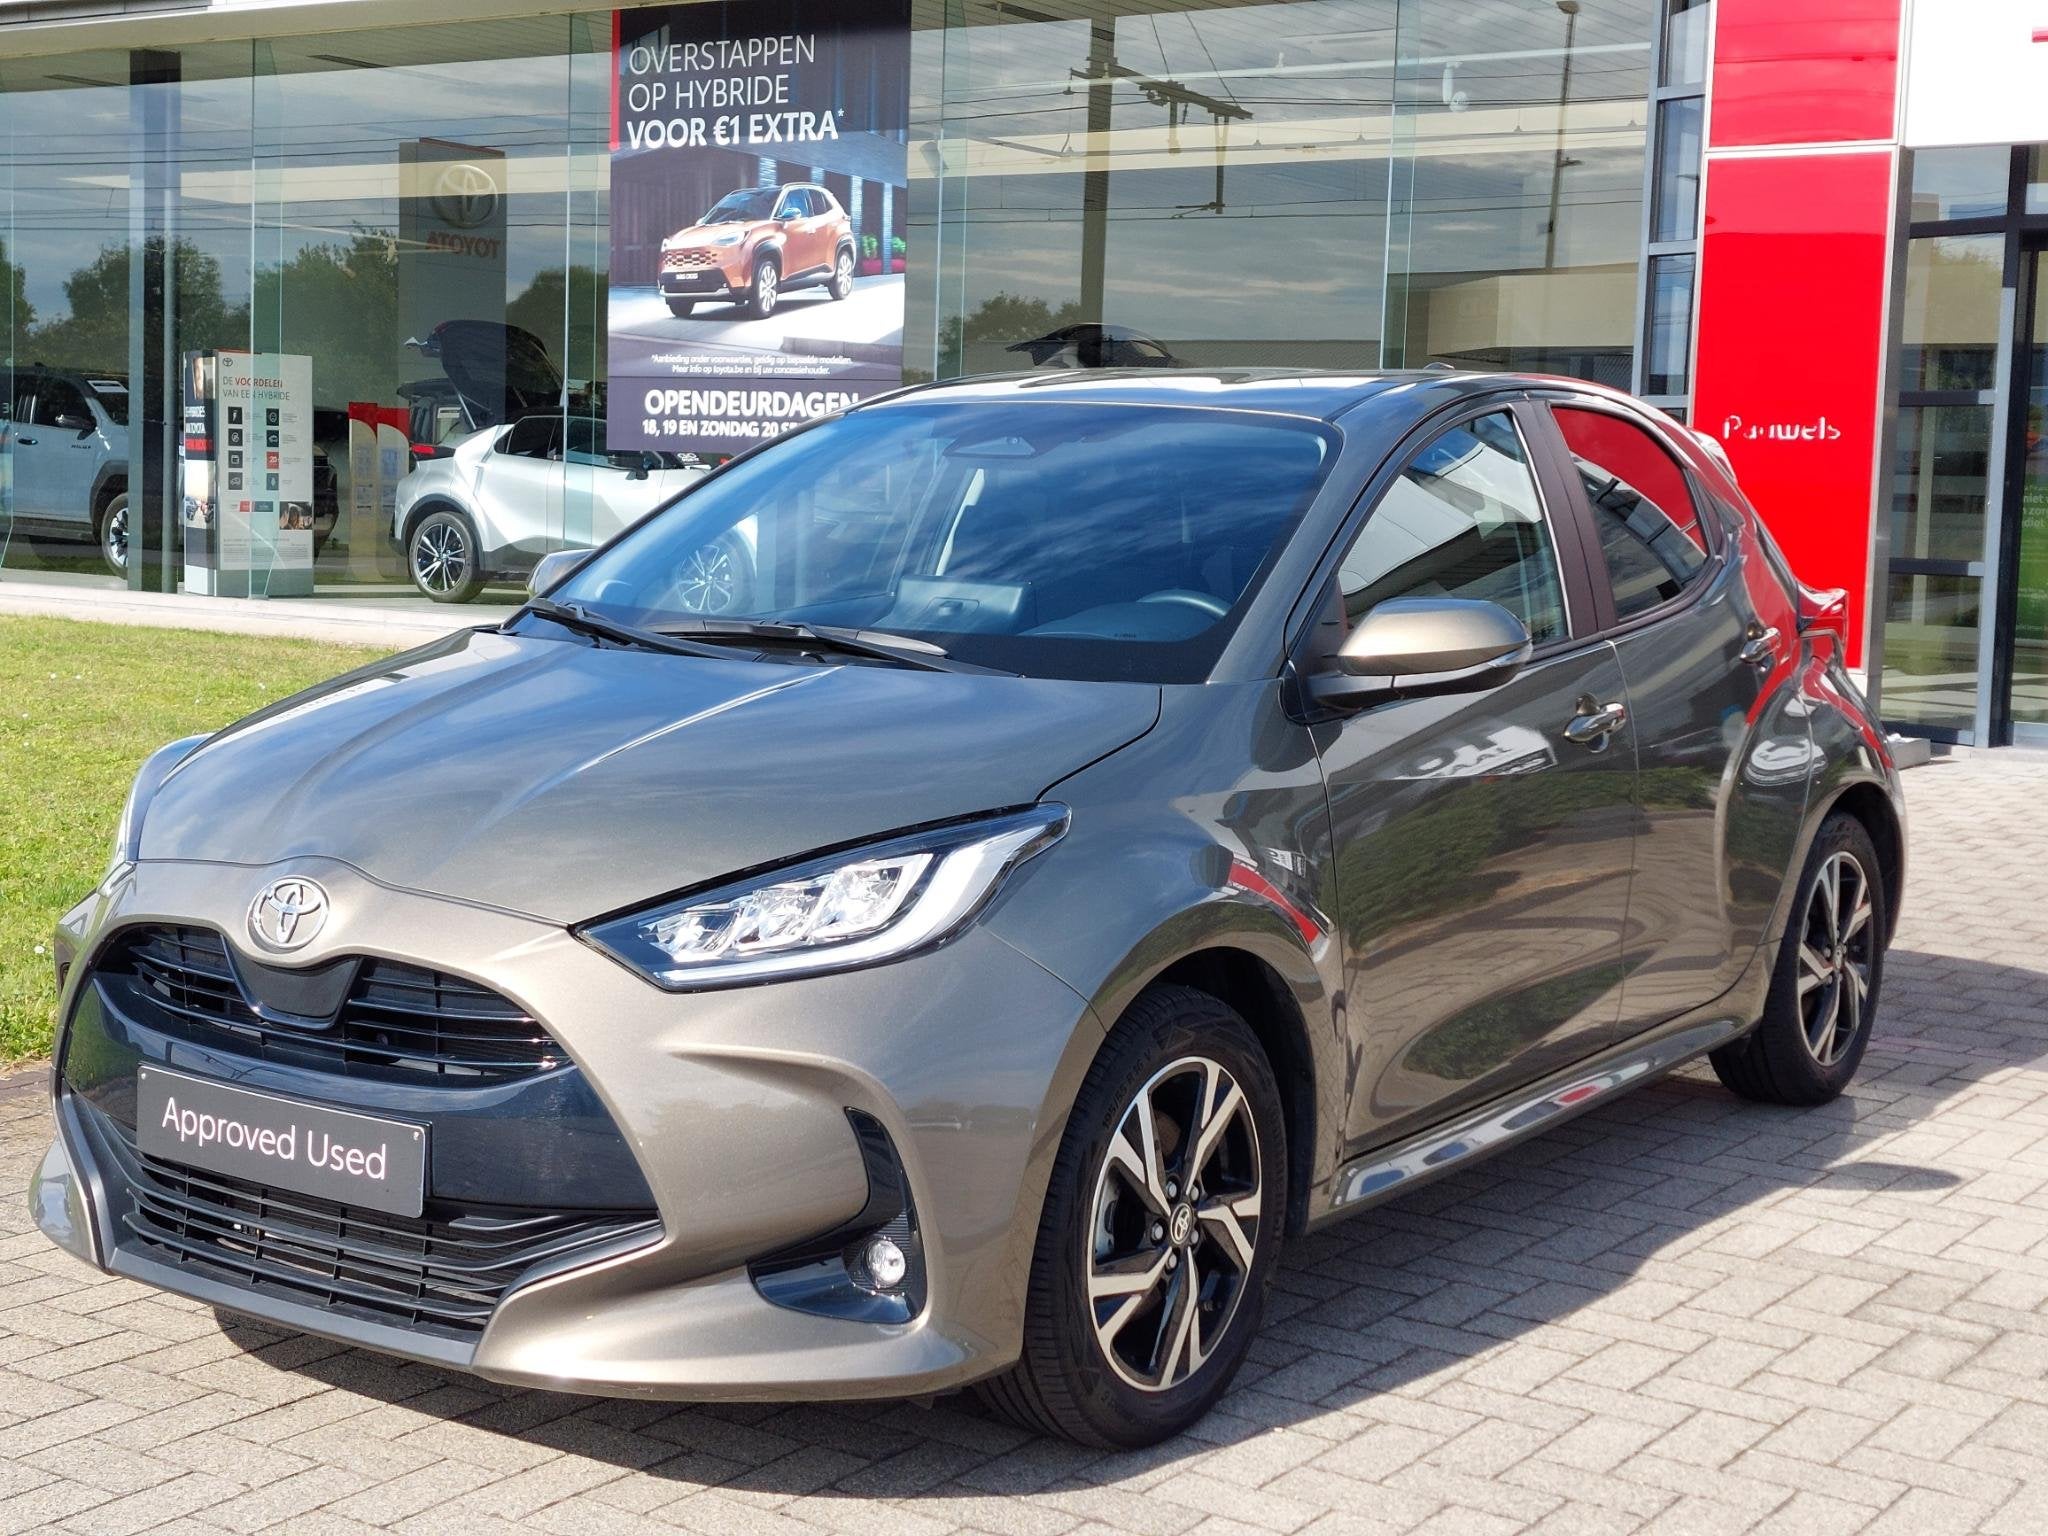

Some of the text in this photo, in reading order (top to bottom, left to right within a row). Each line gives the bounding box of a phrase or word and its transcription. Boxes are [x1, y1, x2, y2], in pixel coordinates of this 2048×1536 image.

[629, 34, 815, 75] OVERSTAPPEN
[628, 74, 789, 112] OP HYBRIDE
[627, 117, 707, 149] VOOR
[713, 115, 740, 146] €1
[222, 376, 283, 388] DE VOORDELEN
[222, 389, 239, 398] VAN
[259, 392, 291, 401] HYBRIDE
[644, 389, 859, 418] OPENDEURDAGEN
[642, 419, 660, 437] 18,
[663, 420, 678, 435] 19
[679, 421, 698, 436] EN
[700, 421, 760, 438] ZONDAG
[761, 421, 779, 438] 20
[162, 1096, 387, 1181] Approved Used
